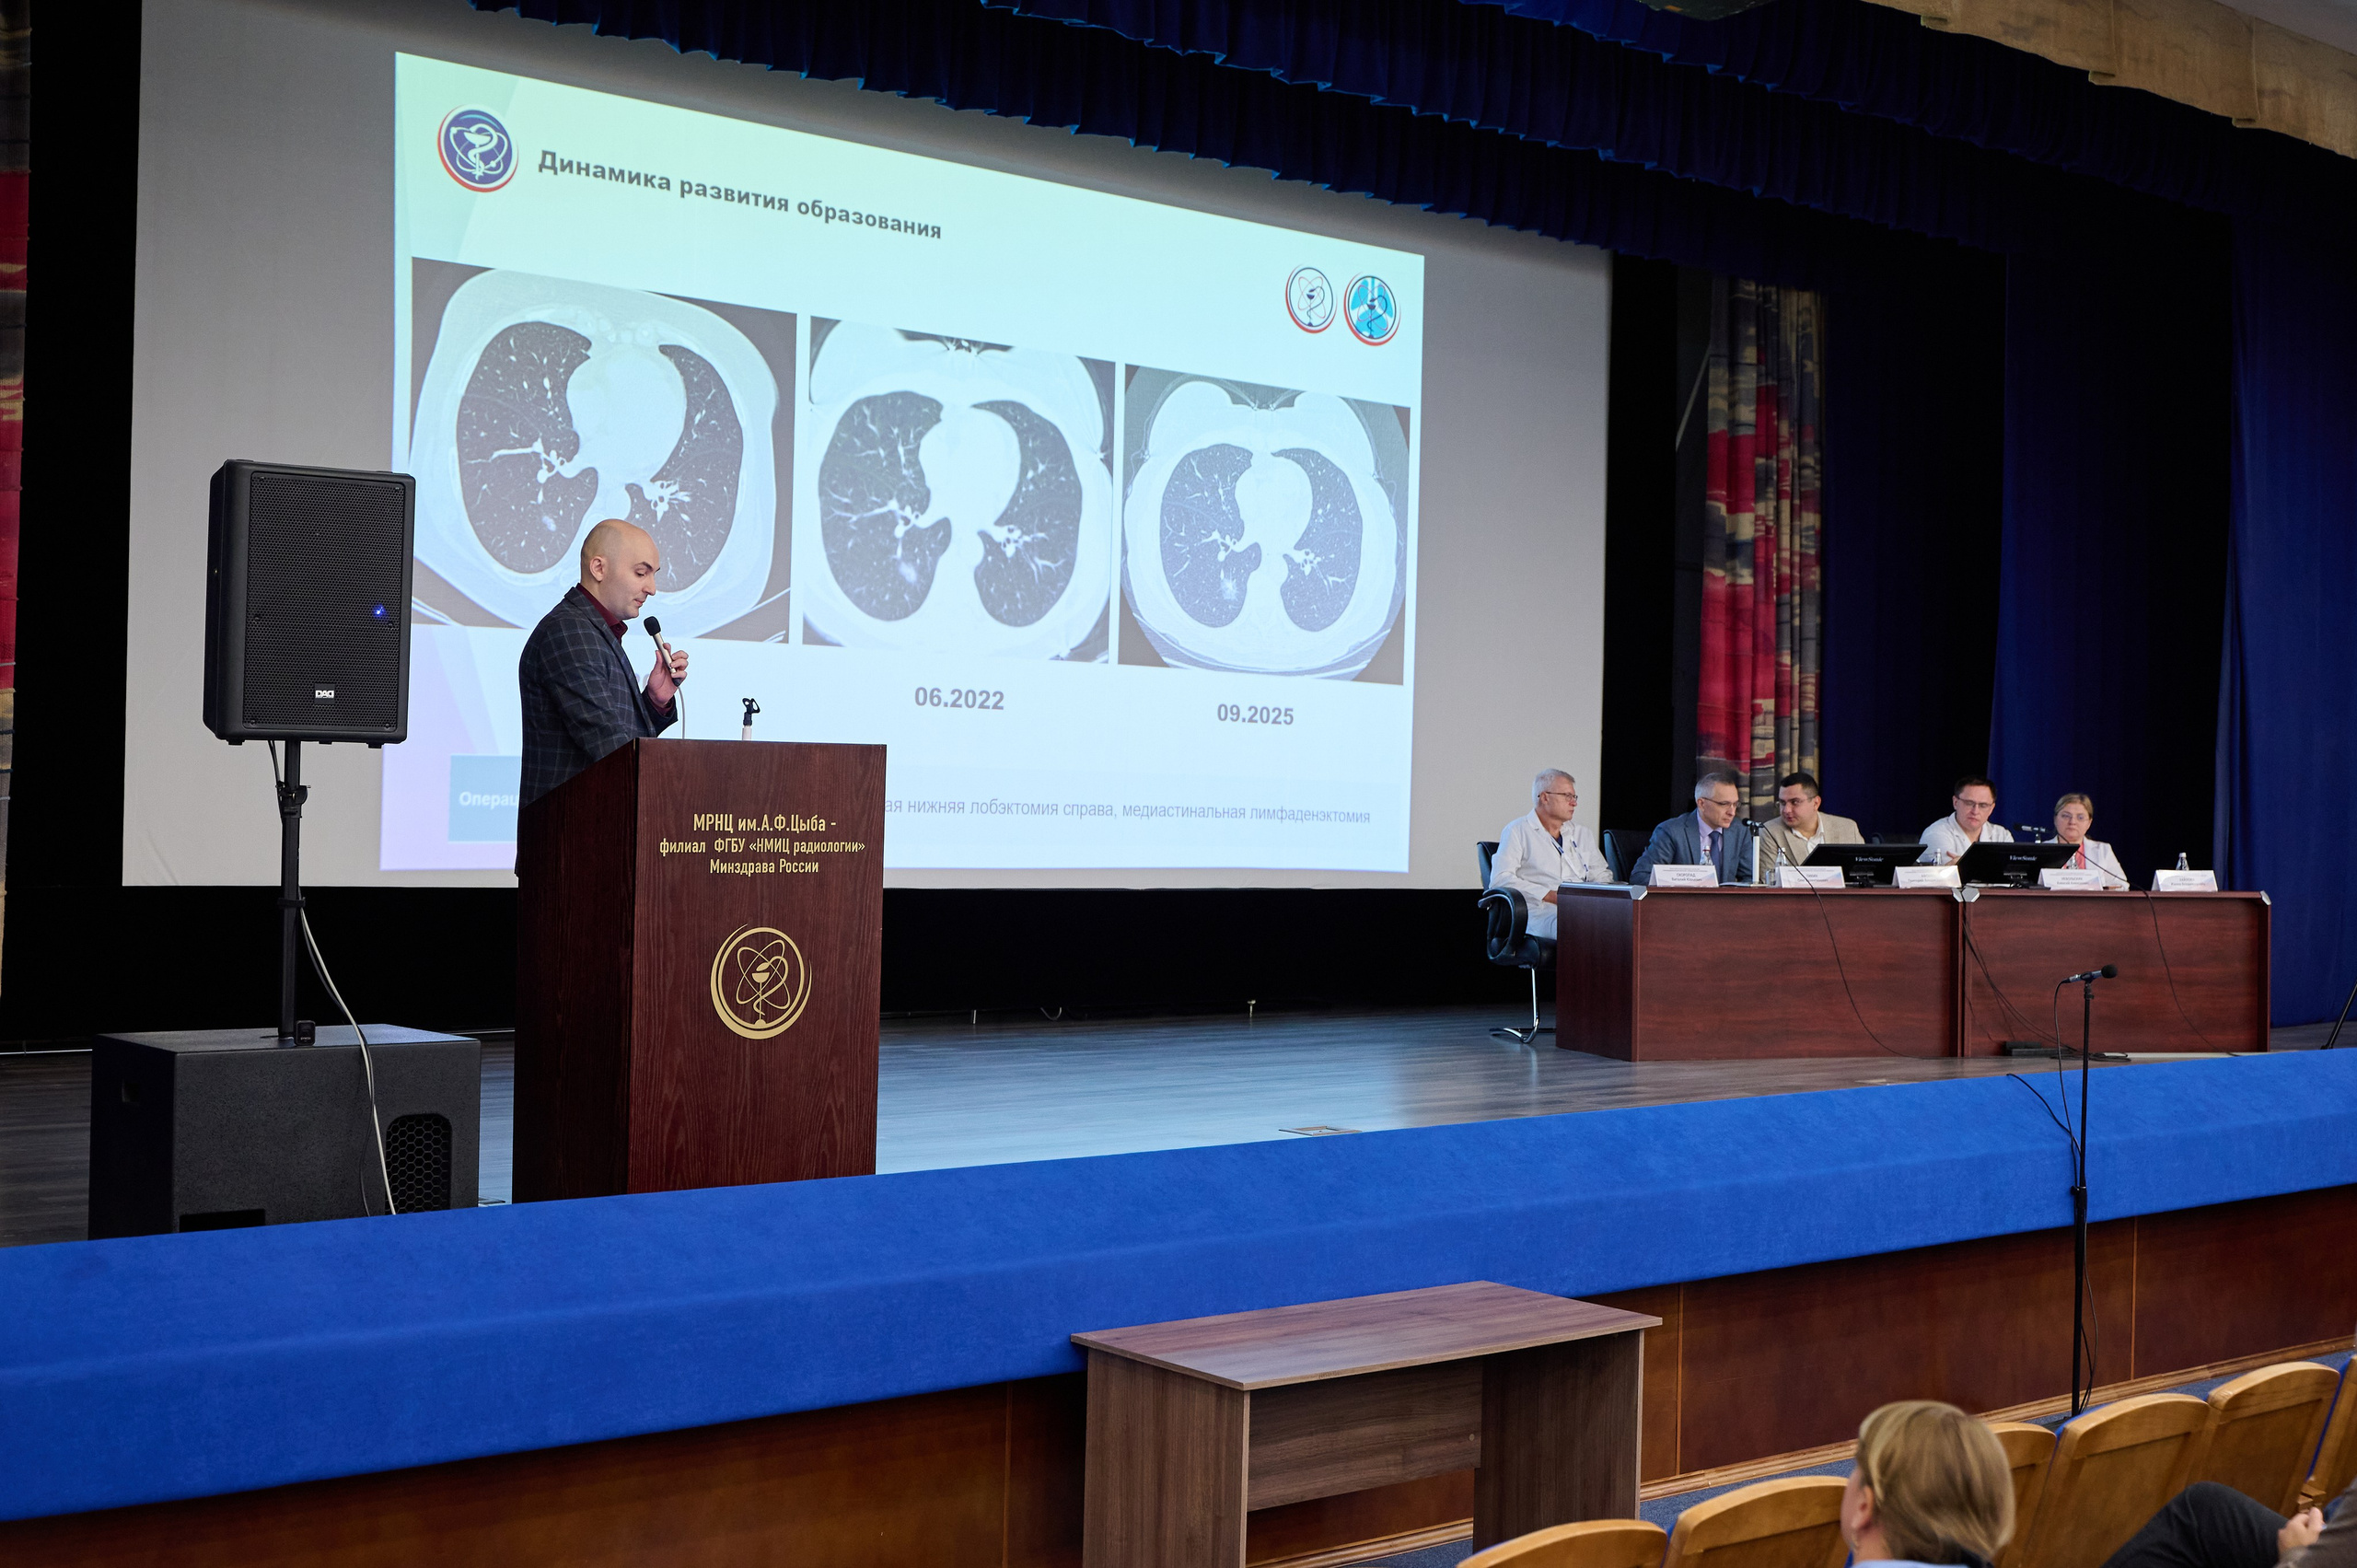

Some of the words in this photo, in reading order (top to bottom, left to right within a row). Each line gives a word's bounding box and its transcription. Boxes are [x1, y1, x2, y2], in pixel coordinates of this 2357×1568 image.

[538, 149, 671, 192] Динамика
[679, 180, 789, 213] развития
[796, 198, 942, 239] образования
[914, 686, 1004, 711] 06.2022
[1216, 703, 1295, 726] 09.2025
[908, 799, 965, 814] нижняя
[970, 798, 1059, 816] лобэктомия
[1062, 803, 1117, 820] справа,
[1122, 804, 1246, 820] медиастинальная
[1249, 806, 1371, 823] лимфаденэктомия
[693, 814, 734, 833] МРНЦ
[737, 815, 826, 833] им.А.Ф.Цыба
[659, 837, 706, 857] филиал
[714, 838, 746, 854] ФГБУ
[749, 837, 790, 855] «НМИЦ
[793, 841, 865, 856] радиологии»
[710, 858, 775, 877] Минздрава
[779, 858, 819, 874] России
